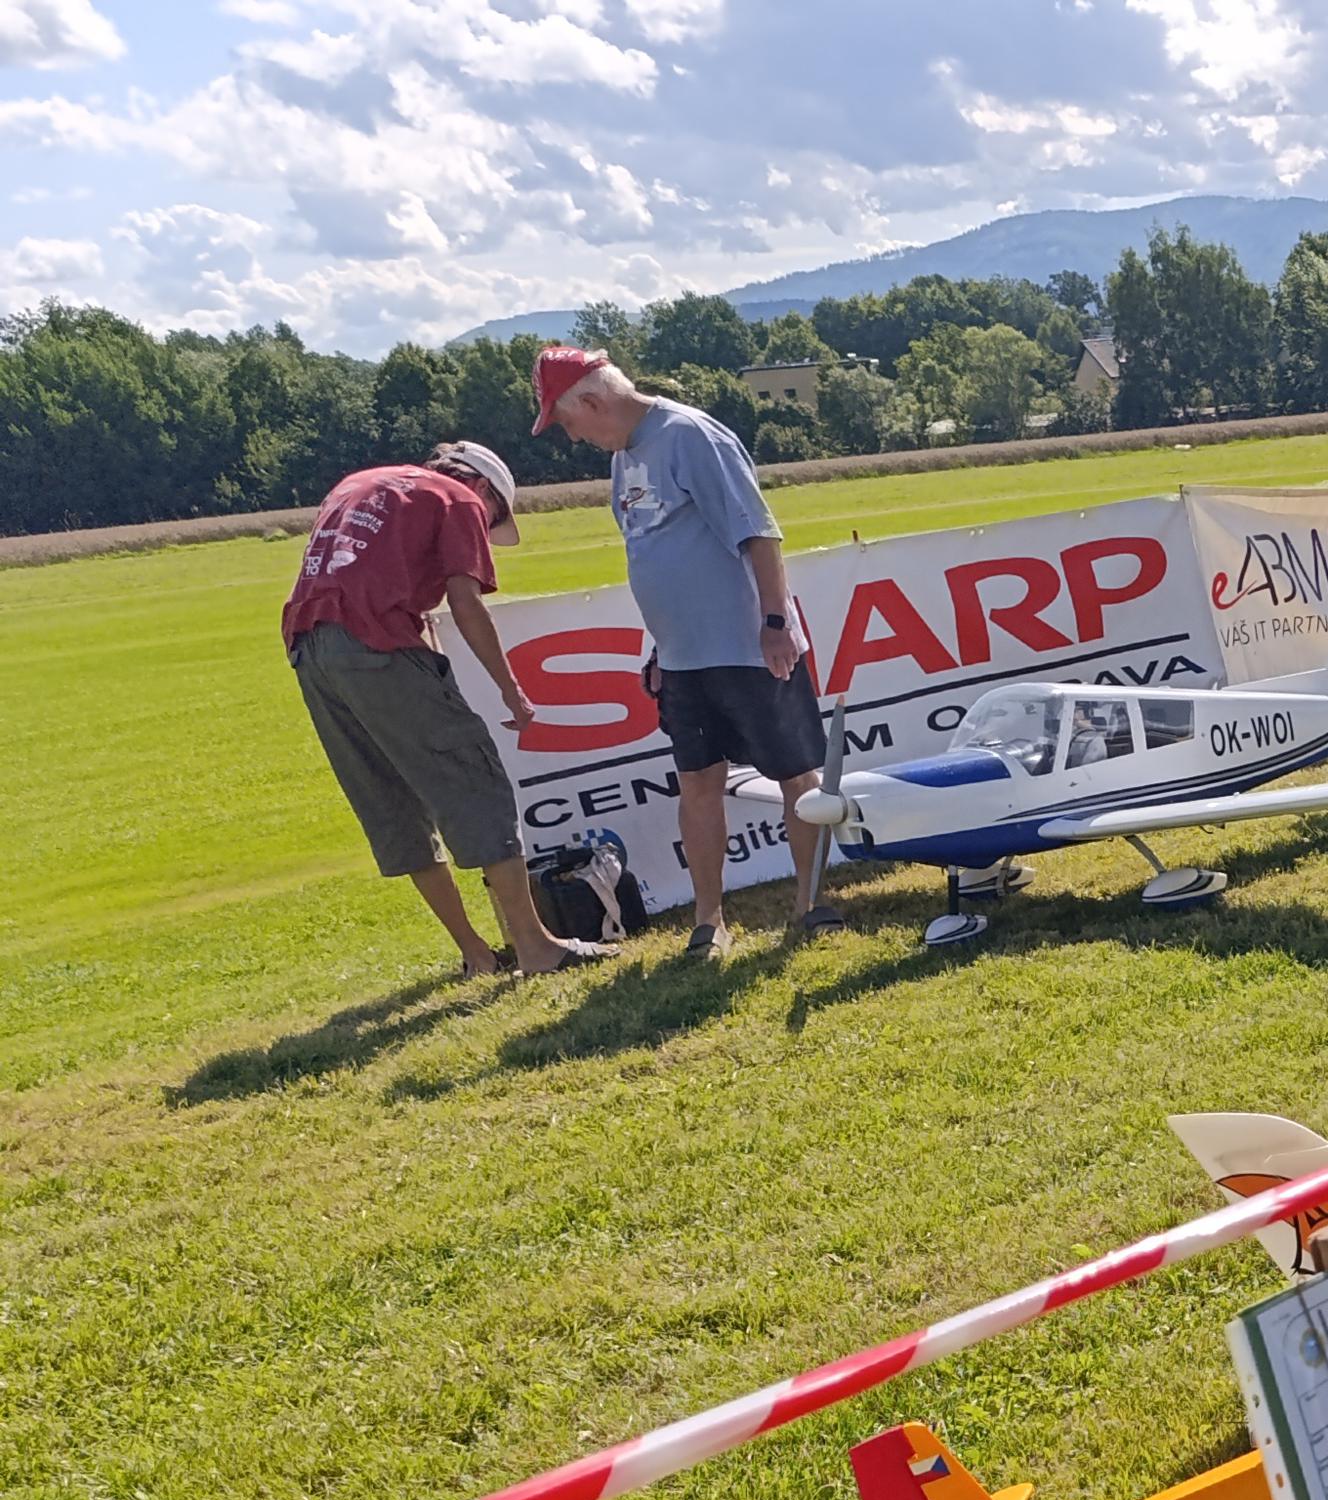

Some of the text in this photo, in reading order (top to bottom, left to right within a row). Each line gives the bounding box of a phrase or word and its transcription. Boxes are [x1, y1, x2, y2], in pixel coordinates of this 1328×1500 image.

[507, 537, 1167, 752] SARP
[1220, 624, 1251, 648] VÁŠ
[1253, 622, 1270, 644] IT
[927, 655, 1207, 732] OAVA
[1211, 710, 1295, 757] OK-WOI
